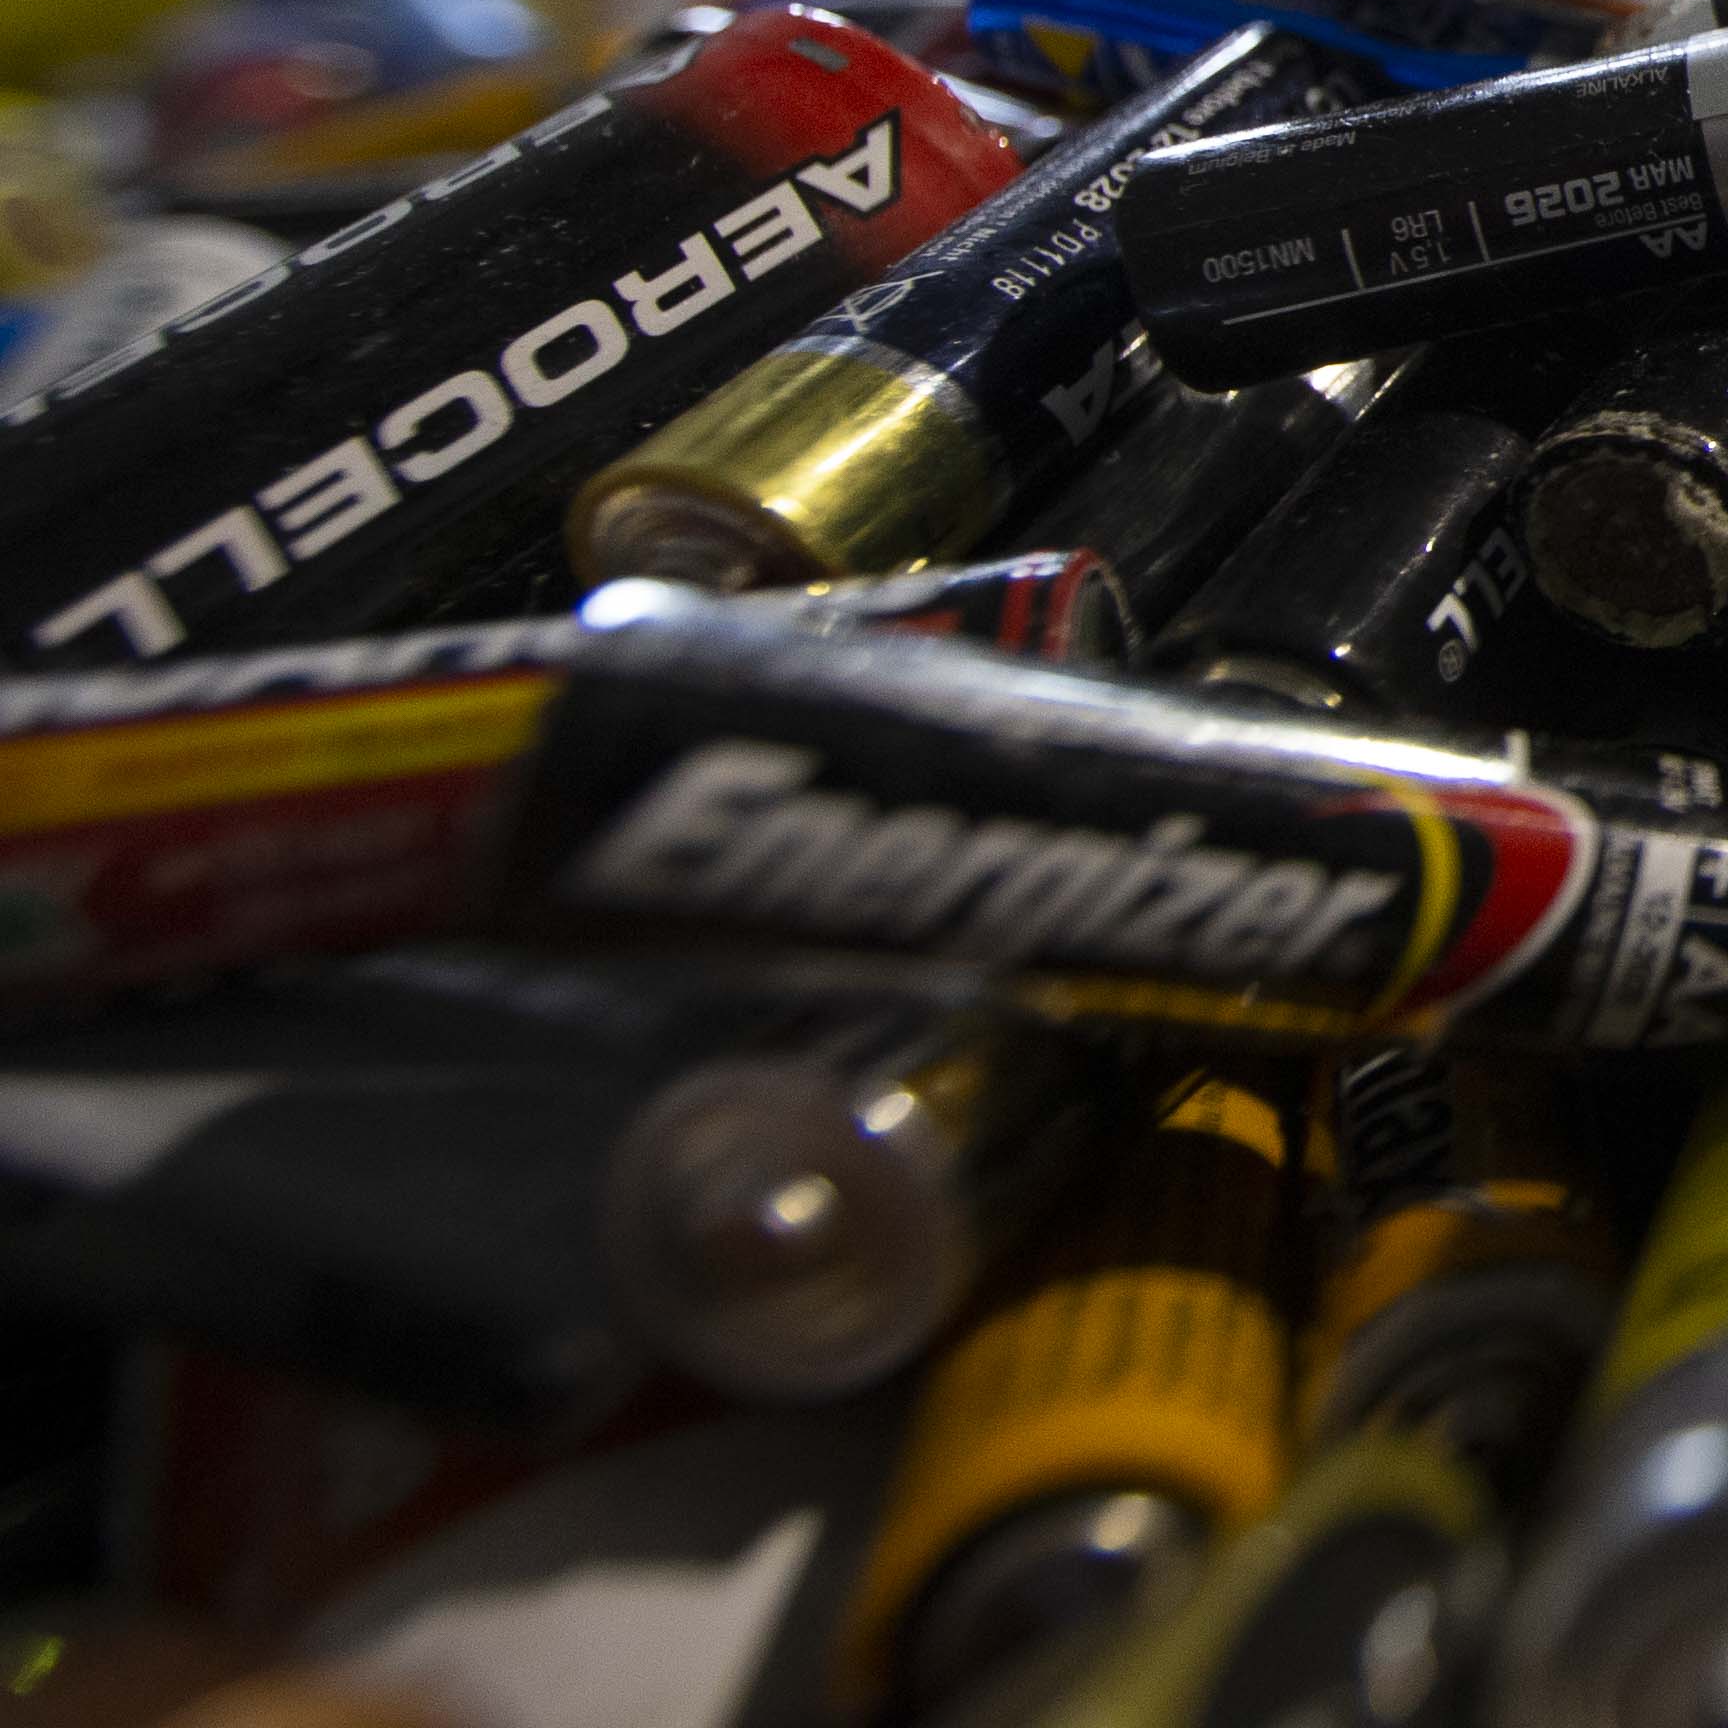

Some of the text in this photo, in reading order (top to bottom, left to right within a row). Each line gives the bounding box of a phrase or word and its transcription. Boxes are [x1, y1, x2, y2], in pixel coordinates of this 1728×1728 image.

[1573, 63, 1669, 101] ALKALINE
[1502, 153, 1695, 227] MAR 2026
[1594, 189, 1702, 232] Best Before
[1388, 207, 1444, 245] LR6
[1639, 218, 1710, 262] AA
[1200, 235, 1315, 283] MN1500
[34, 121, 893, 658] AEROCELL
[572, 734, 1400, 972] Energizer
